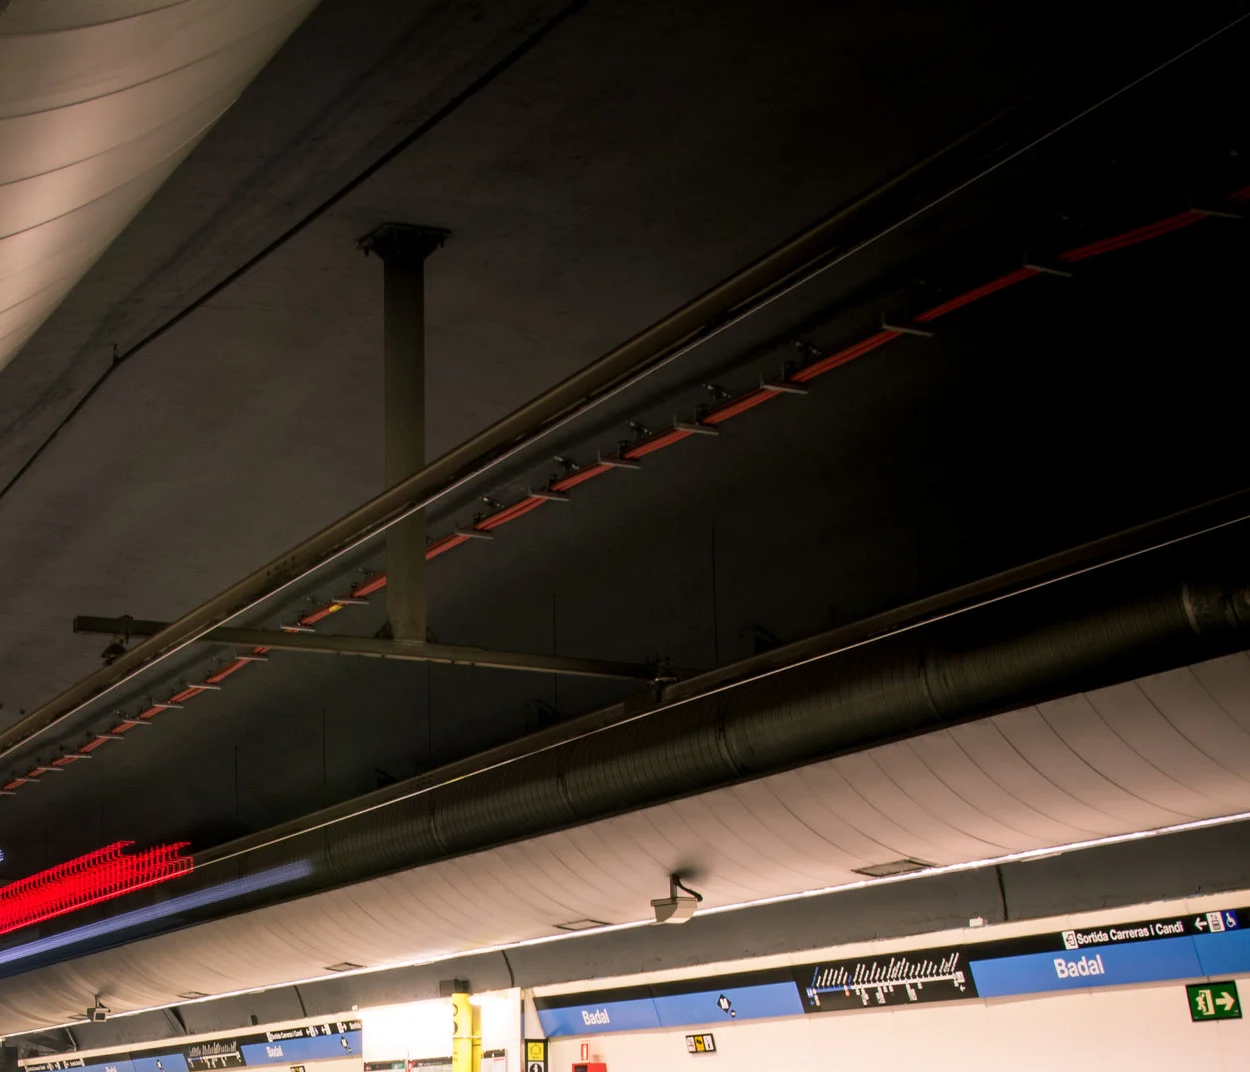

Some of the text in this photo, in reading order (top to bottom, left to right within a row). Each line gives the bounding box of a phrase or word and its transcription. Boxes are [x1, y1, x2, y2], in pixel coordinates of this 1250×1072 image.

[1077, 929, 1109, 945] Sortida
[1109, 926, 1149, 941] Carreras
[1155, 921, 1184, 935] Candi
[1054, 954, 1105, 979] Badal
[581, 1008, 610, 1026] Badal
